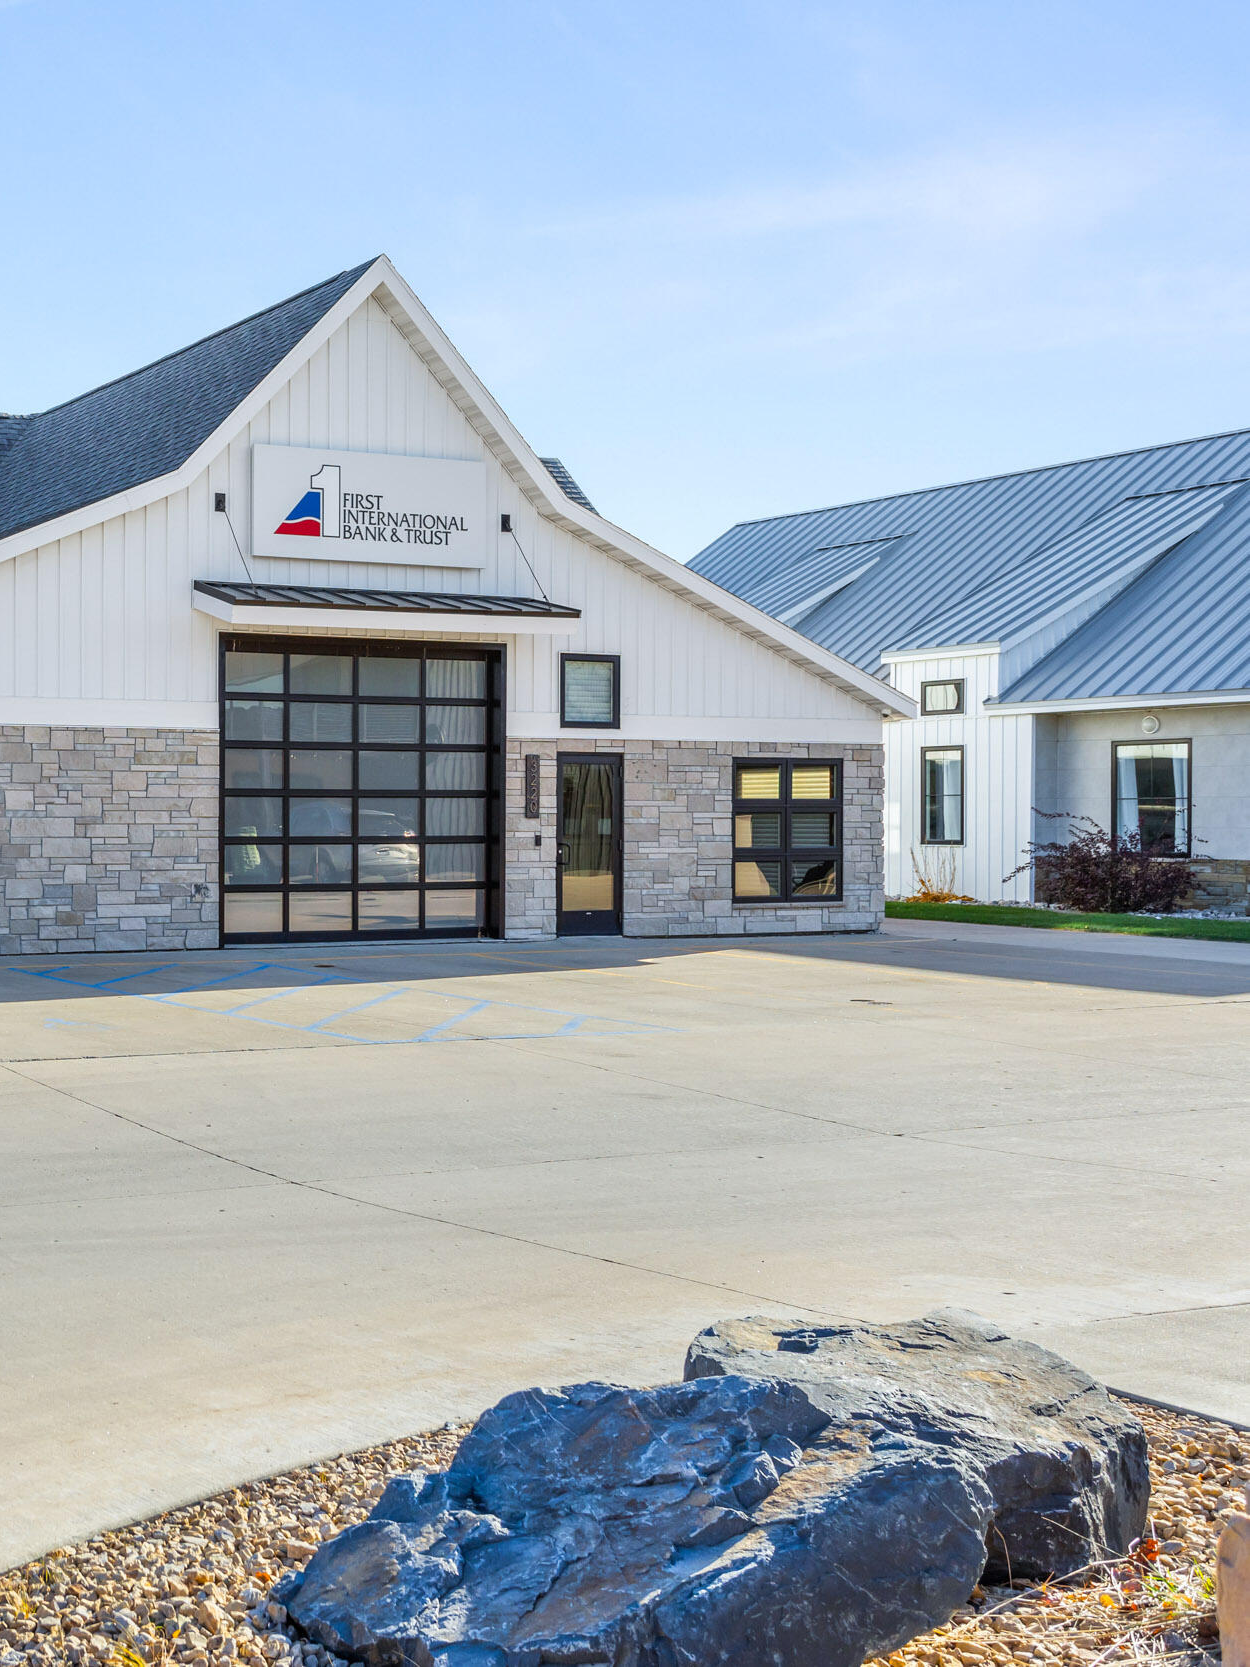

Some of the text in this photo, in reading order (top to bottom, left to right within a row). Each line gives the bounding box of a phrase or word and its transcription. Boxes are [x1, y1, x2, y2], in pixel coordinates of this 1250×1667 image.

[343, 493, 383, 510] FIRST
[343, 509, 468, 531] INTERNATIONAL
[343, 525, 451, 546] BANK & TRUST
[530, 760, 538, 813] 3220
